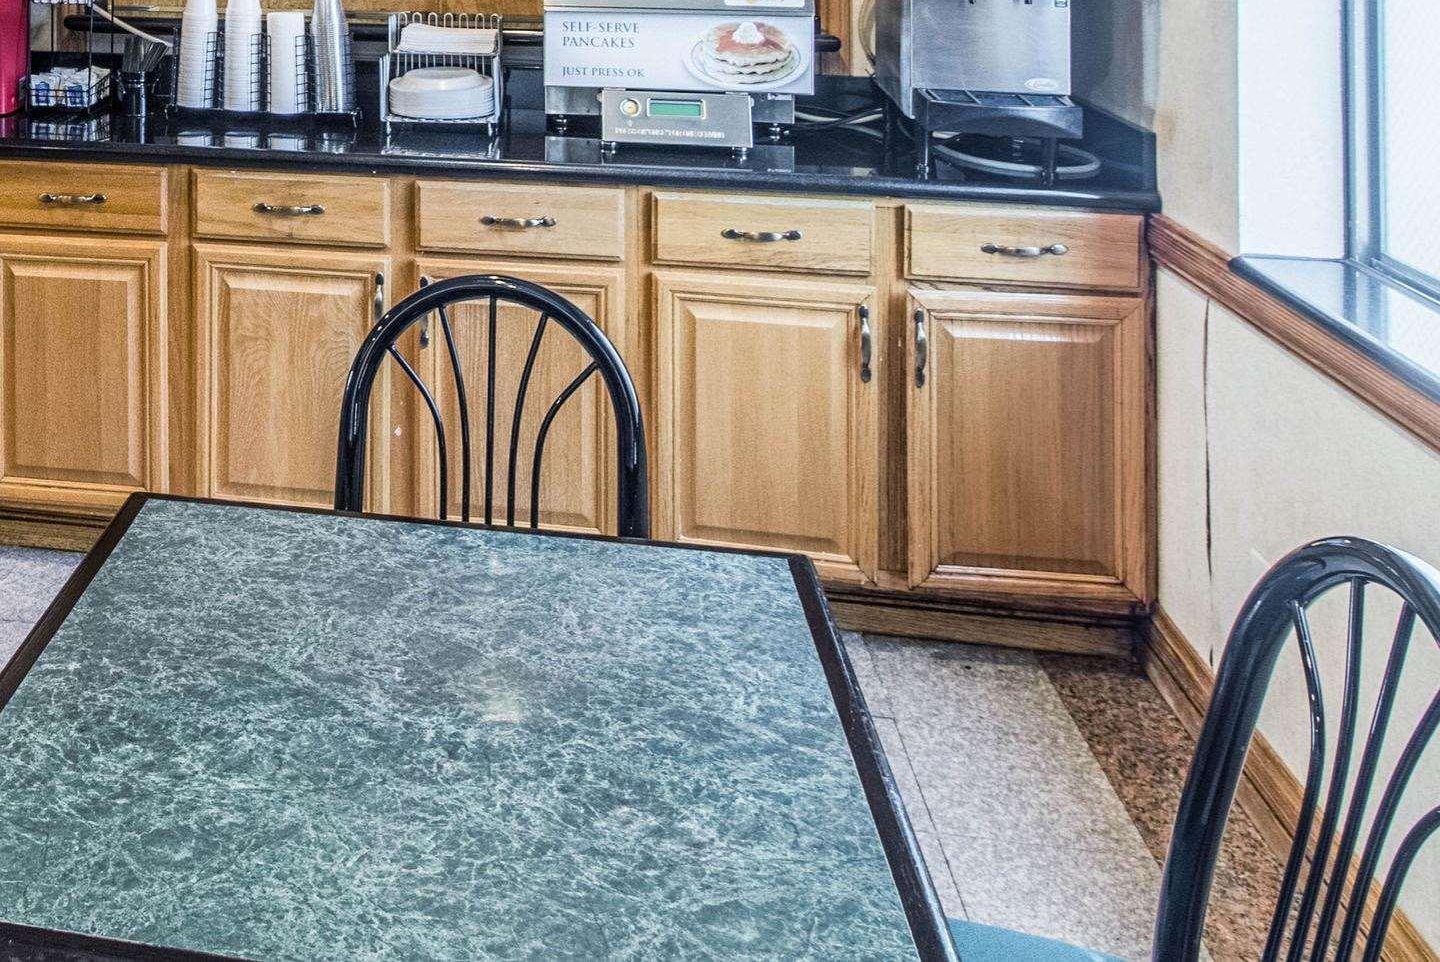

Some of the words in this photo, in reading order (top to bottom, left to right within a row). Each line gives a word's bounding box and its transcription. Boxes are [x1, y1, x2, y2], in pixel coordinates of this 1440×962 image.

[562, 21, 639, 34] SELF-SERVE
[563, 36, 635, 48] PANCAKES
[562, 66, 586, 76] JUST
[591, 67, 624, 77] PRESS
[627, 68, 645, 78] OK
